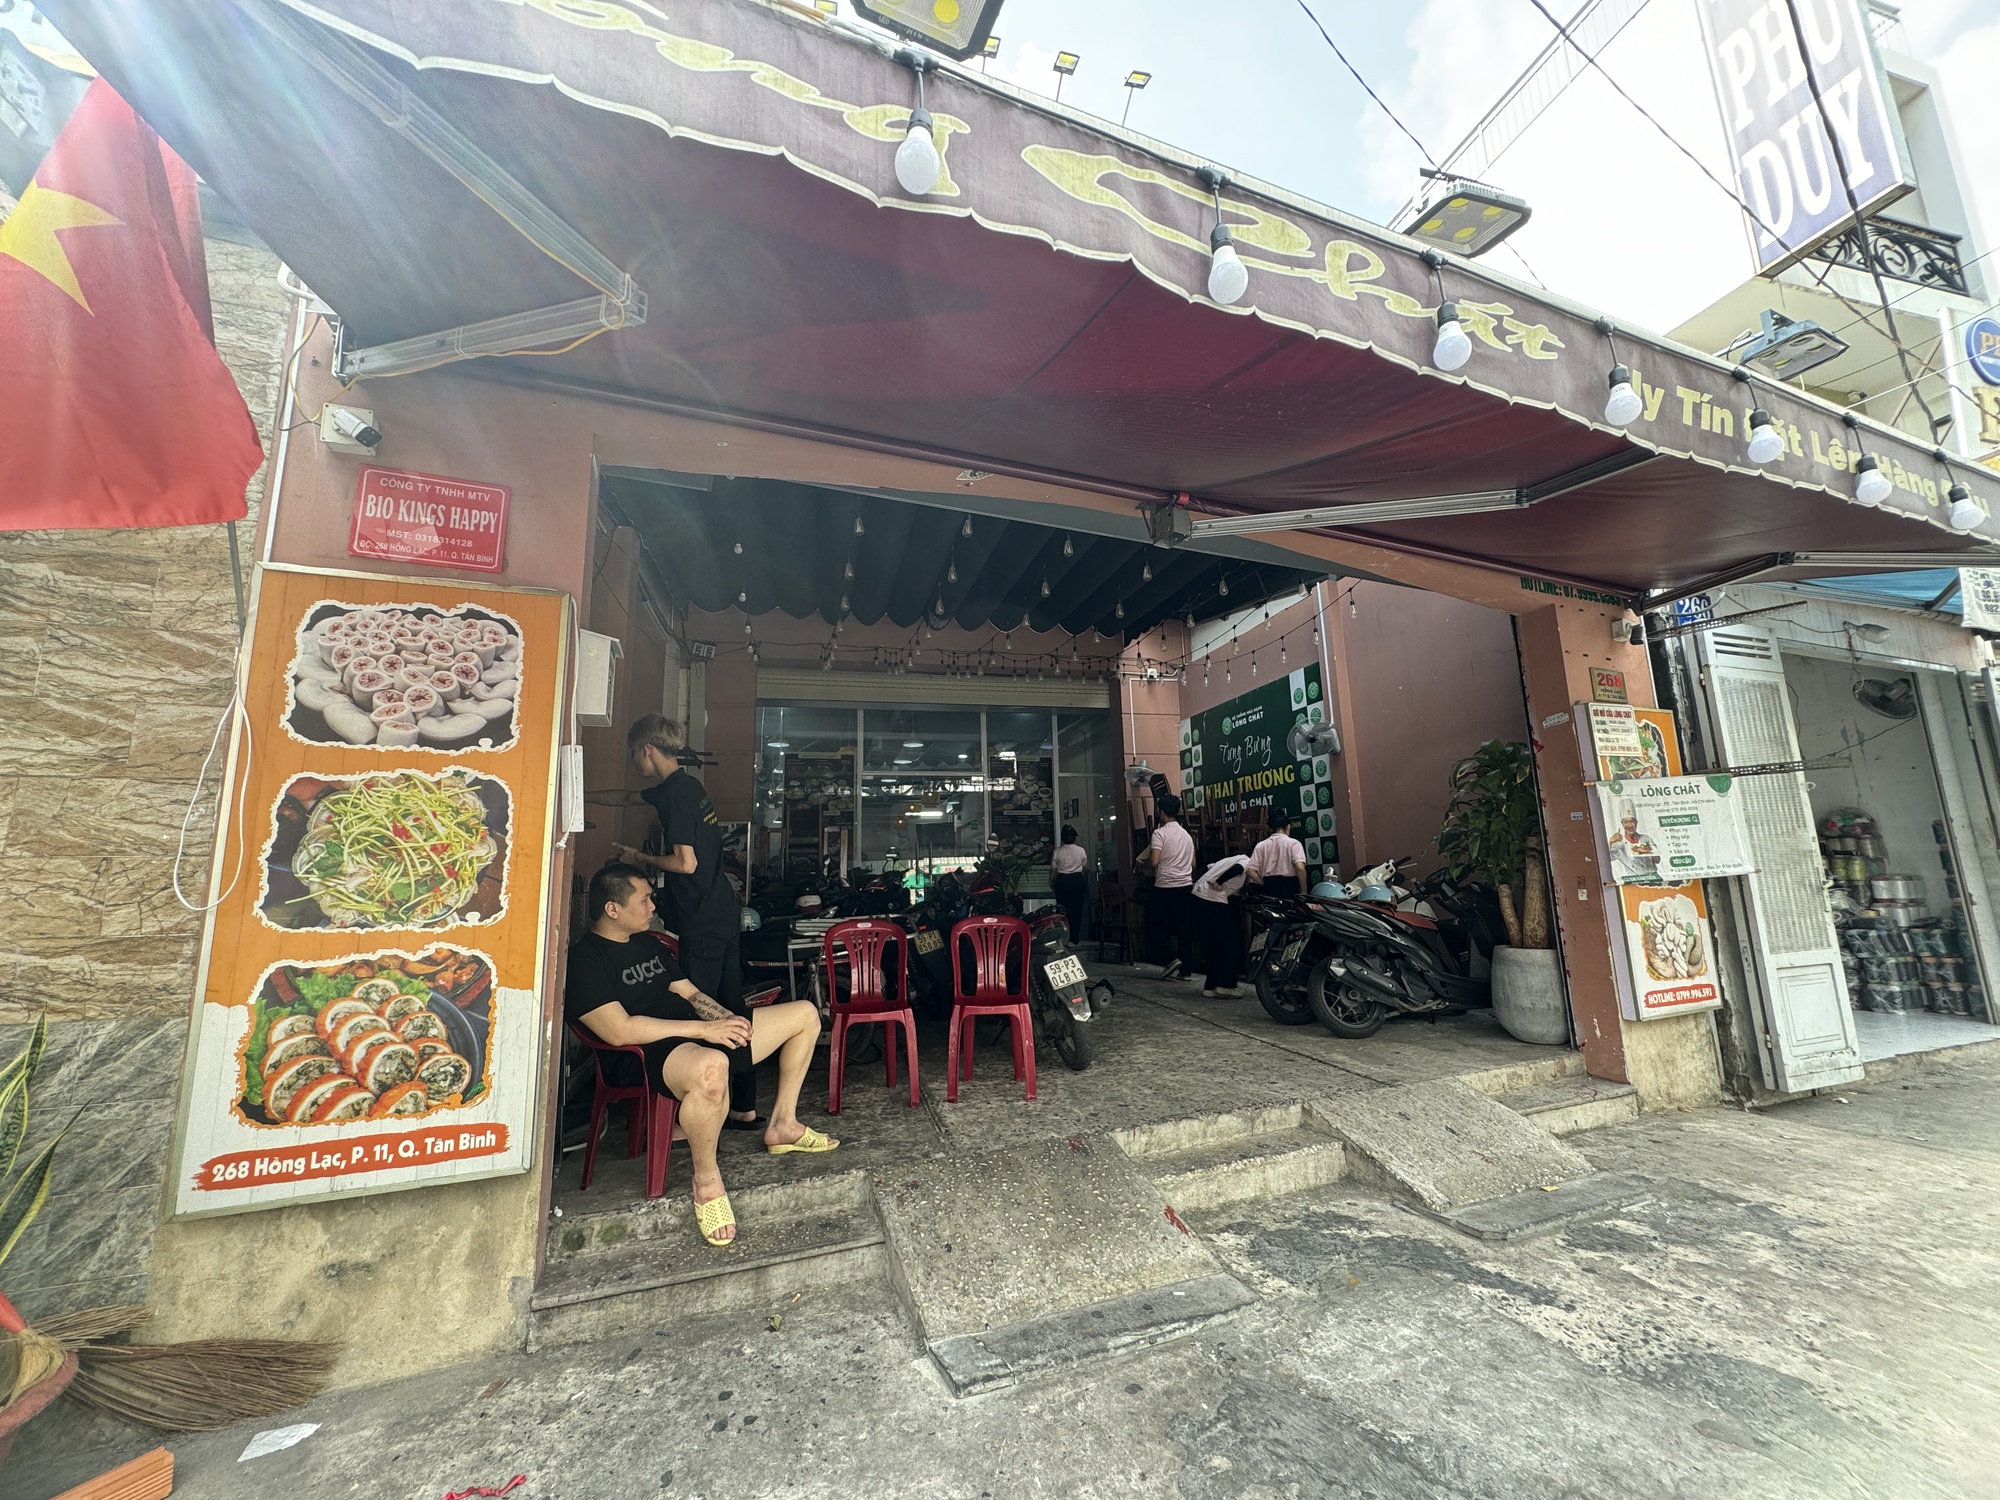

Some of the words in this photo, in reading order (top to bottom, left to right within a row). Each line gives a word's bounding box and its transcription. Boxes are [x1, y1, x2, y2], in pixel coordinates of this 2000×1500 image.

[500, 0, 971, 196] òng
[1739, 67, 1875, 250] DUY
[1676, 385, 1734, 437] Tín
[1871, 451, 1938, 507] Hàng
[380, 477, 414, 491] CÔNG
[417, 483, 431, 492] TY
[434, 486, 465, 498] TNHH
[468, 491, 491, 502] MTV
[365, 494, 394, 520] BIO
[398, 498, 446, 527] KINGS
[449, 506, 499, 534] HAPPY
[386, 530, 412, 540] MST:
[415, 533, 474, 548] 0318314128
[374, 542, 388, 550] 268
[451, 552, 459, 560] Q.
[461, 552, 475, 562] TÂN
[476, 552, 494, 564] BÌNH
[1596, 672, 1622, 688] 268
[1250, 793, 1273, 807] CHÁT
[1640, 784, 1671, 798] LÒNG
[1674, 782, 1701, 796] CHÁT
[1049, 958, 1076, 975] 59-P3
[1648, 992, 1675, 1005] HOTLINE:
[212, 1160, 250, 1182] 268
[310, 1150, 348, 1172] Lạc,
[351, 1146, 369, 1164] P.
[374, 1144, 395, 1164] 11,
[398, 1141, 420, 1160] Q.
[425, 1136, 455, 1155] Tân
[459, 1128, 496, 1152] Bình
